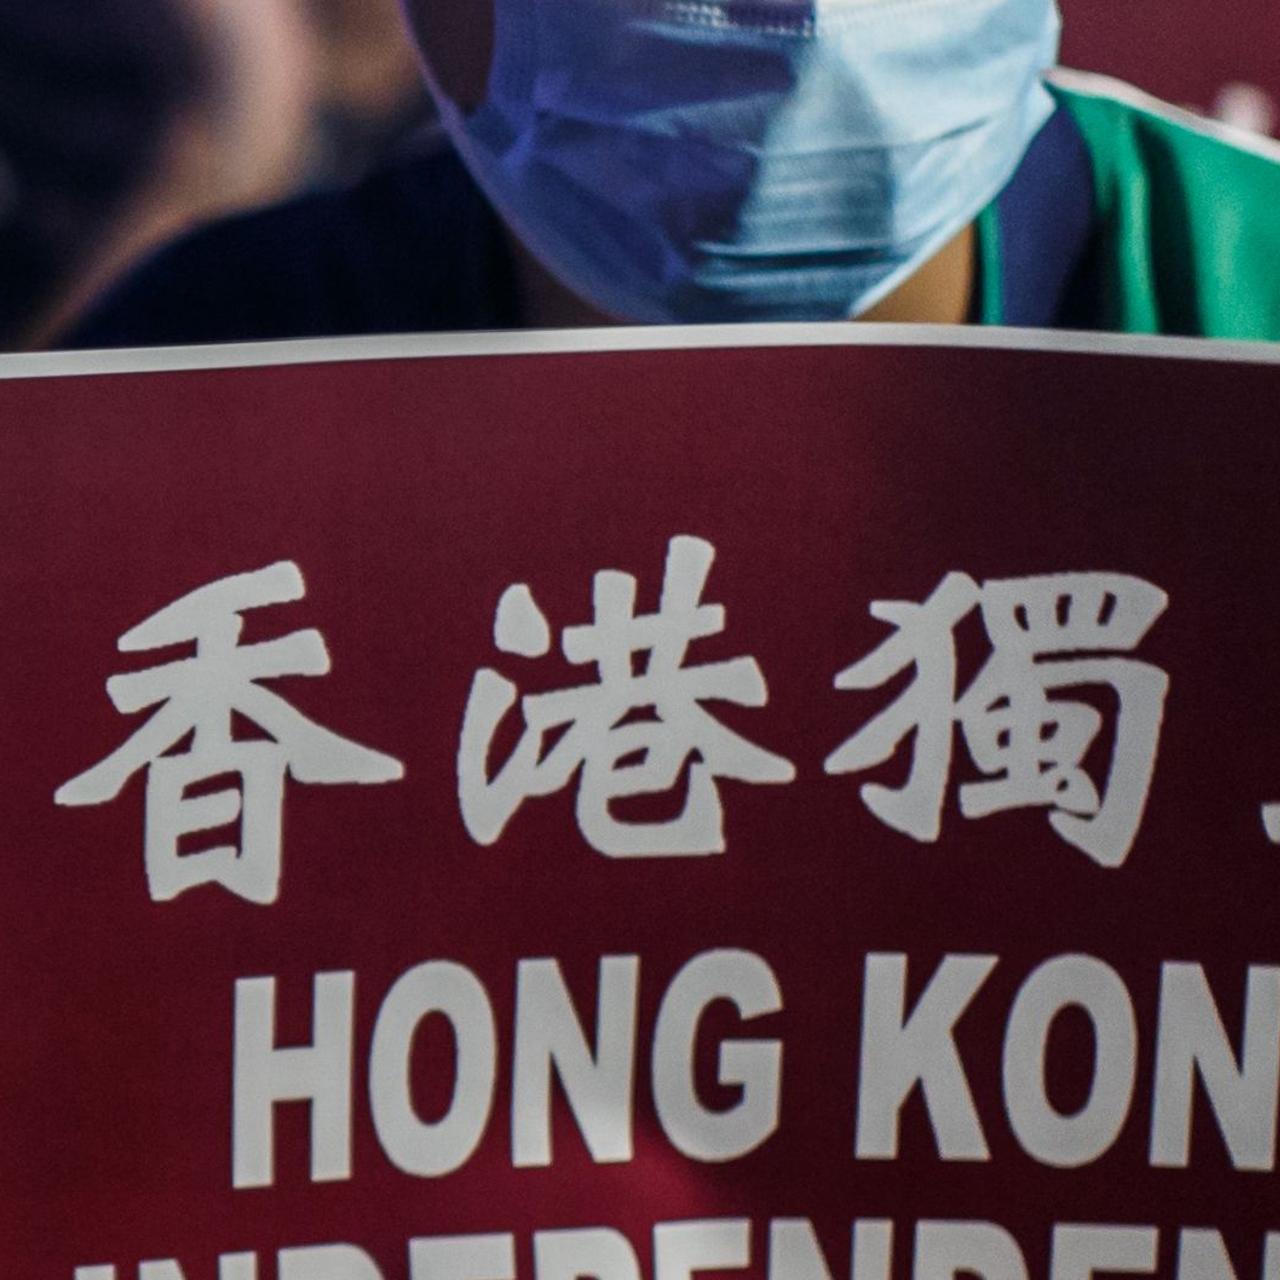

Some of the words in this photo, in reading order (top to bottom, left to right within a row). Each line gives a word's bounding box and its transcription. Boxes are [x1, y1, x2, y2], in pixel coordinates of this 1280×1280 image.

[52, 533, 1280, 906] 香港獨
[232, 947, 784, 1190] HONG
